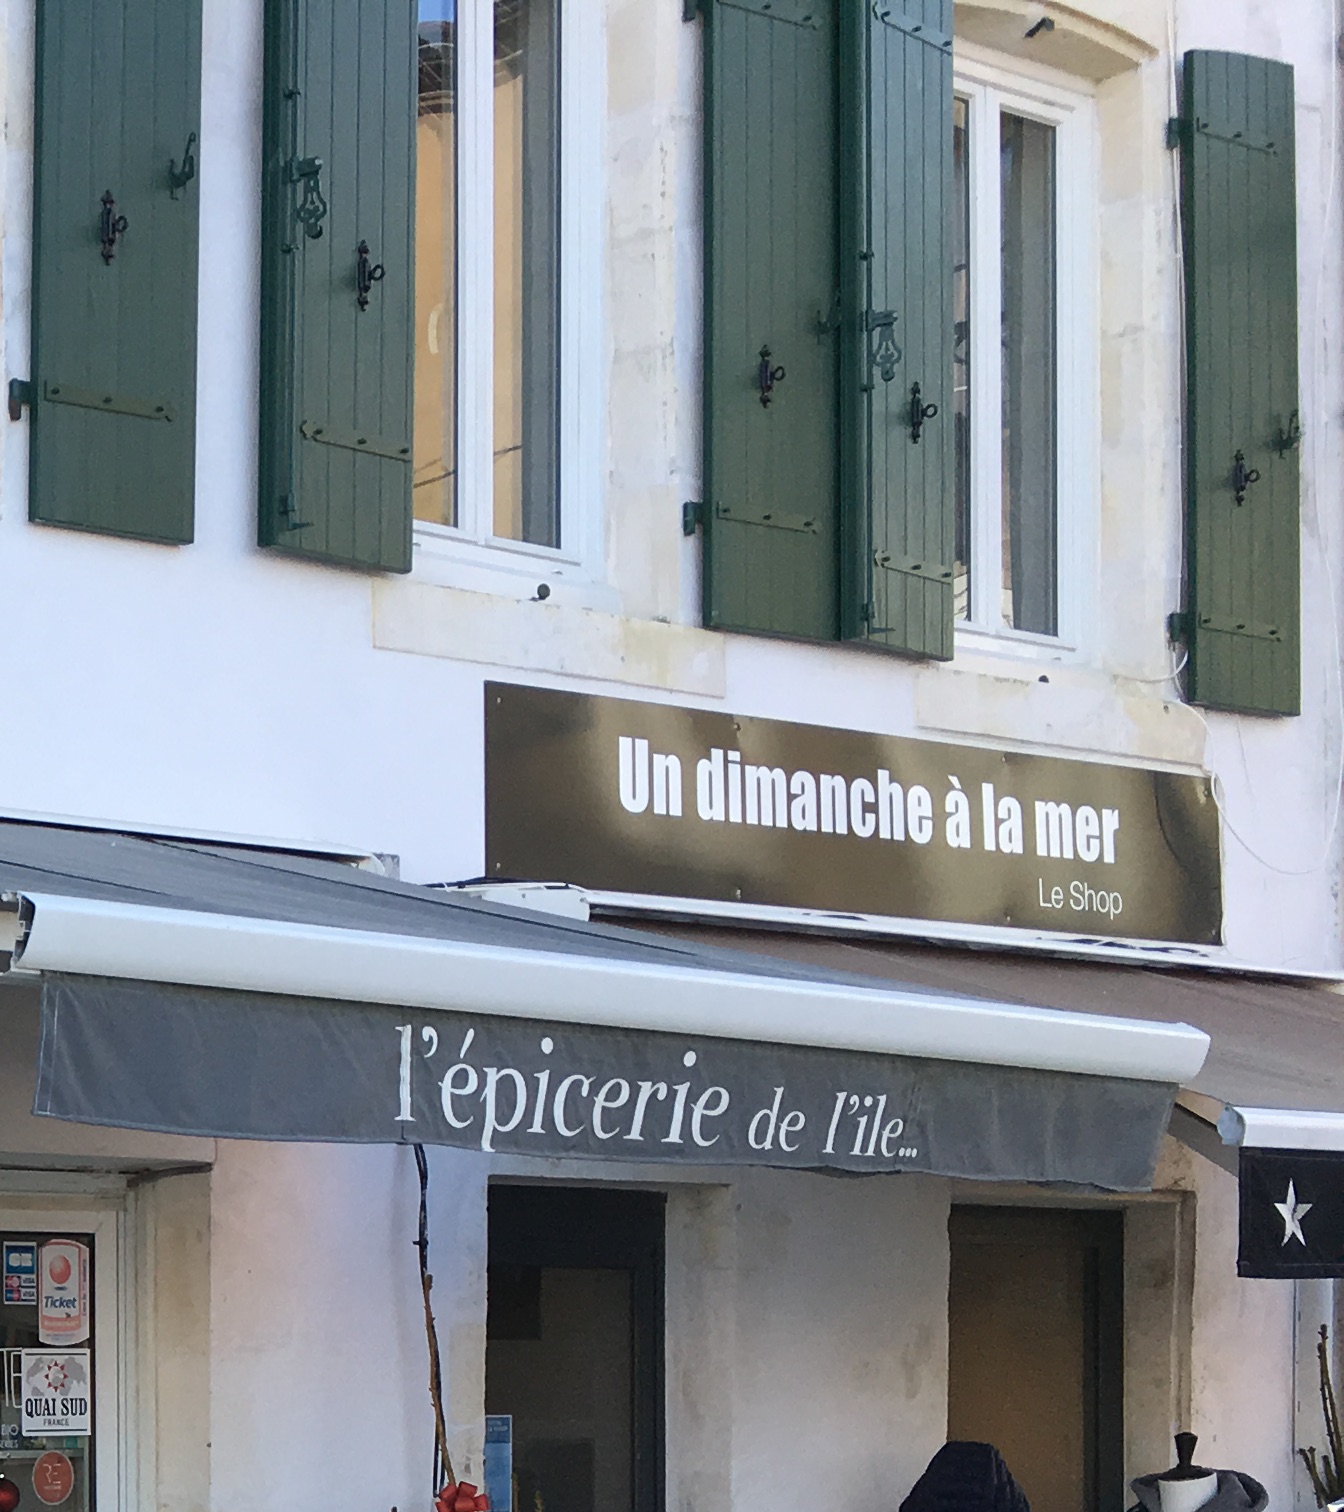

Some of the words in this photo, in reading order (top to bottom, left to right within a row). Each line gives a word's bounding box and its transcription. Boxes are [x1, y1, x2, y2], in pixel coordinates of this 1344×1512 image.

[618, 735, 682, 818] Un
[696, 748, 934, 846] dimanche
[945, 774, 972, 850] à
[982, 781, 1024, 854] la
[1034, 799, 1120, 865] mer
[1038, 877, 1064, 910] Le
[1069, 880, 1124, 922] Shop
[393, 1023, 731, 1153] l'épicerie
[747, 1086, 807, 1153] de
[44, 1296, 78, 1309] Ticket
[25, 1397, 59, 1419] QUAI
[61, 1397, 88, 1418] SUD
[43, 1418, 70, 1427] FRANCE
